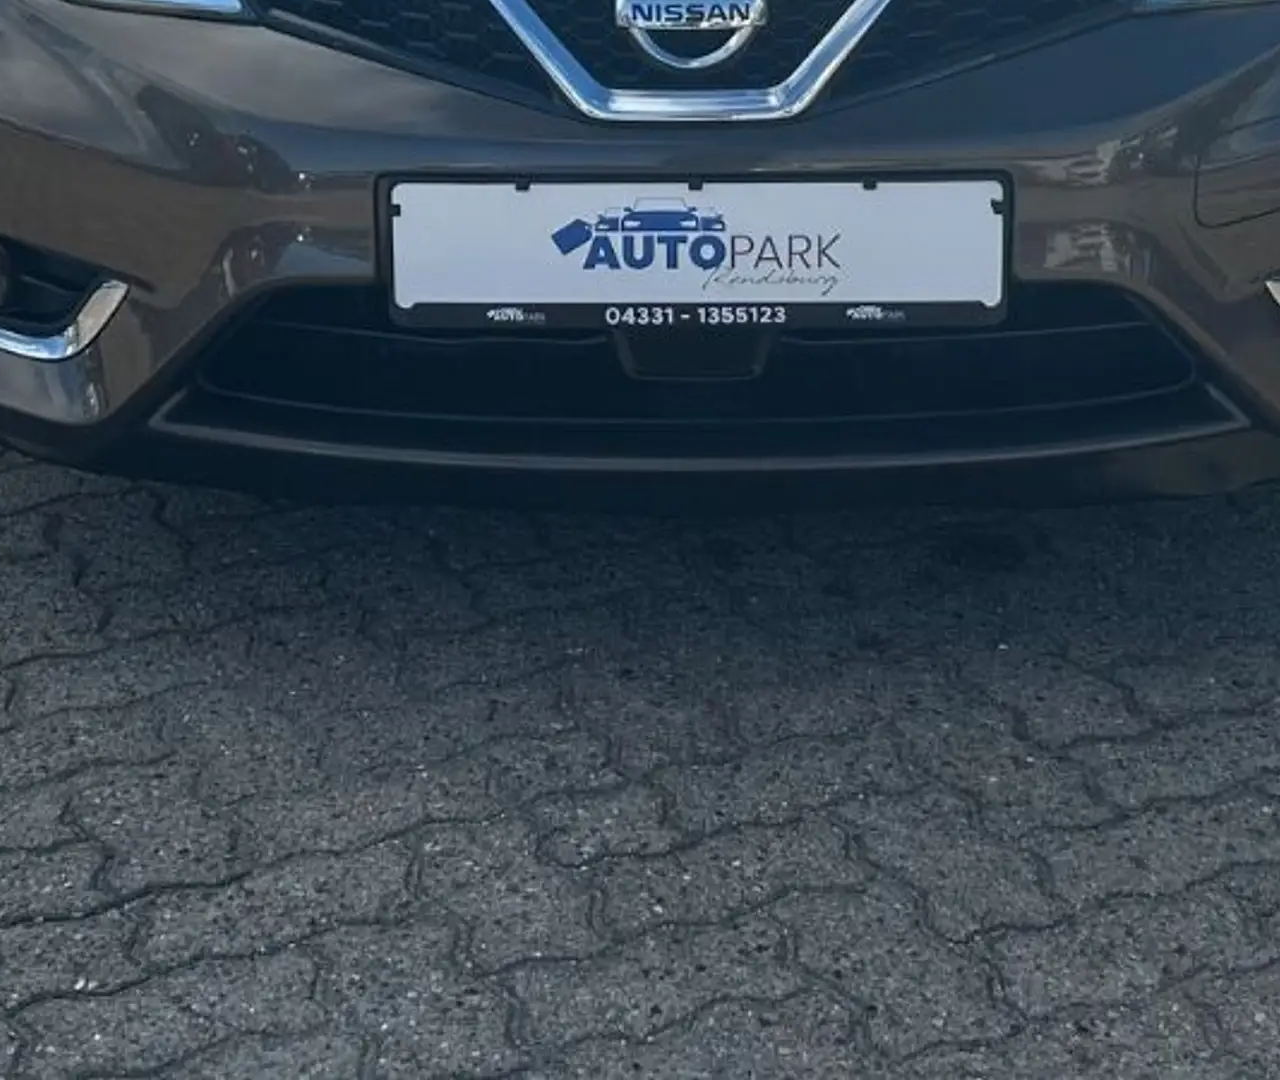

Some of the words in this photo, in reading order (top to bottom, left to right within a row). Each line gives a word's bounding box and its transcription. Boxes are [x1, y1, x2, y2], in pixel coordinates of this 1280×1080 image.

[631, 2, 750, 22] NISSAN
[582, 233, 841, 270] AUTOPARK
[701, 264, 840, 296] Rendsburg
[605, 306, 673, 326] 04331
[697, 306, 787, 325] 1355123
